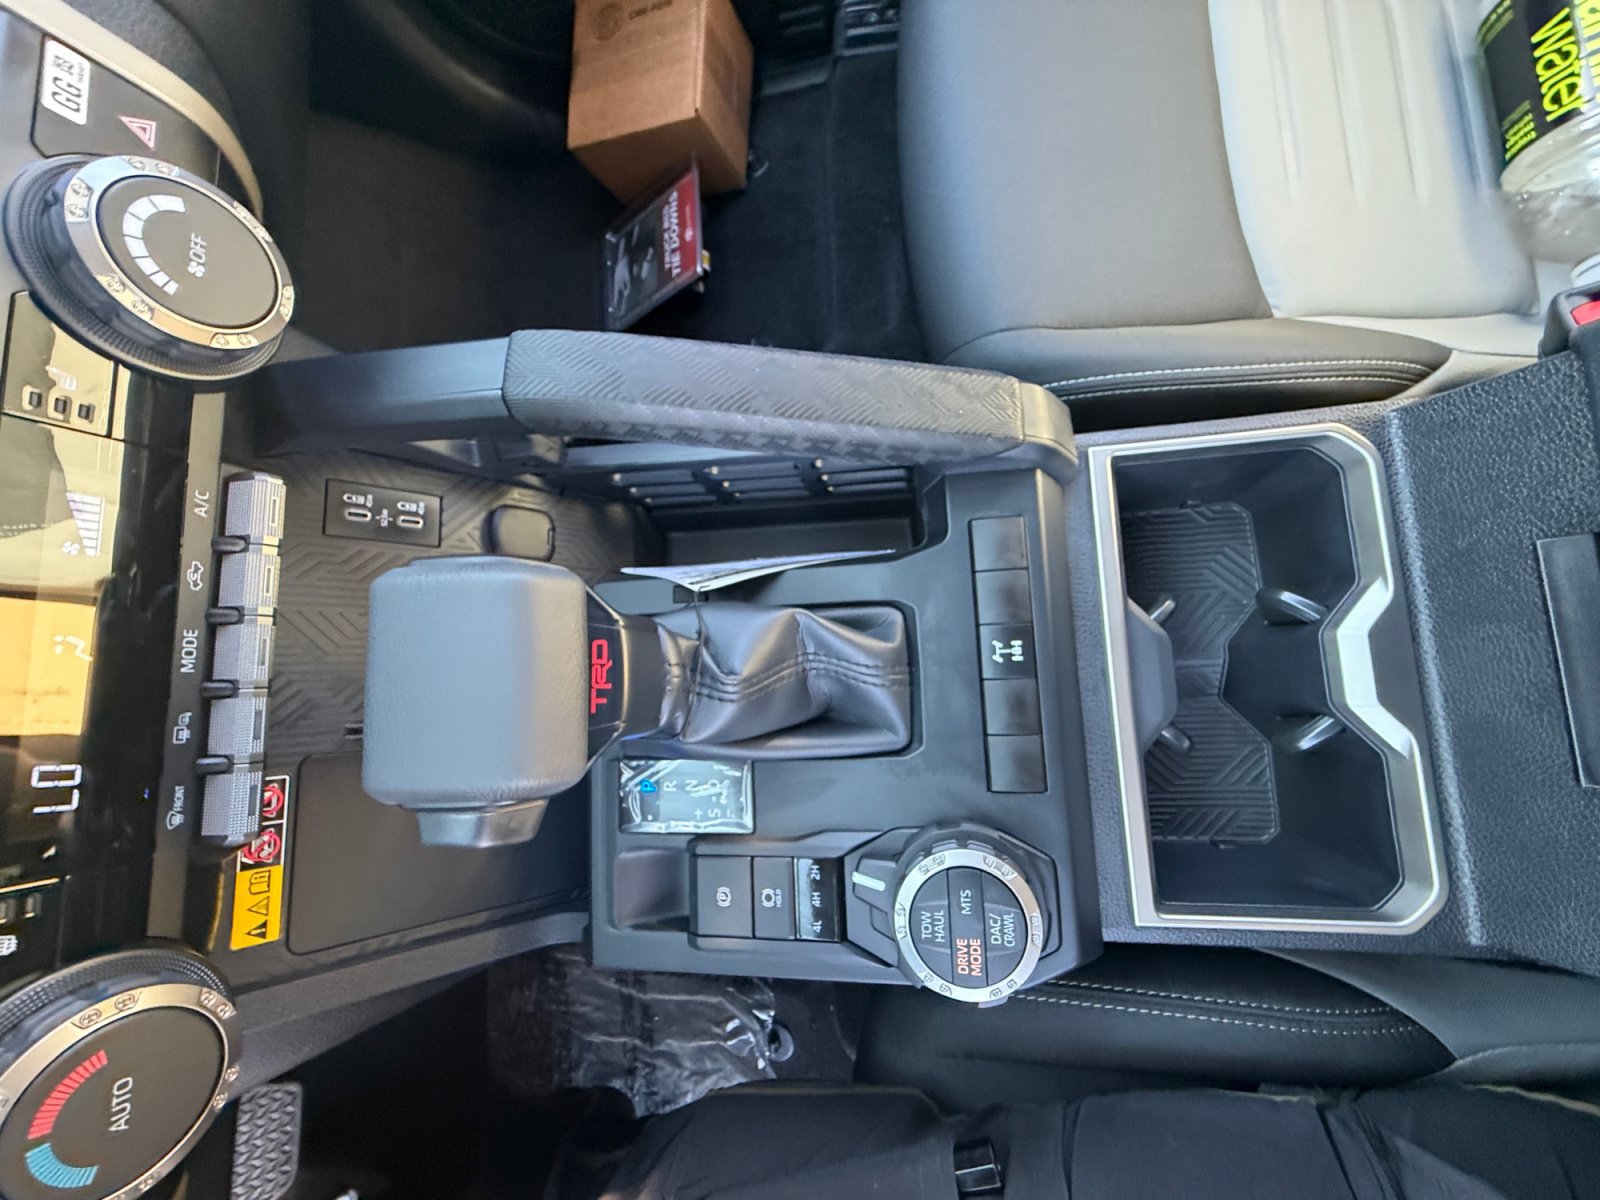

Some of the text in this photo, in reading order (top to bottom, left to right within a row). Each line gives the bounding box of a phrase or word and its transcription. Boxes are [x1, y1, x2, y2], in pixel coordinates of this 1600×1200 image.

[190, 232, 207, 263] OFF
[668, 191, 681, 277] TIE DOWNS
[194, 490, 209, 517] A/C
[180, 629, 198, 673] MODE
[590, 639, 613, 714] TRD
[172, 785, 184, 811] FRONT
[640, 779, 657, 793] P
[664, 780, 677, 792] R
[810, 864, 822, 933] 4L 4H 2H
[960, 889, 972, 914] MTS
[921, 911, 931, 939] TOW
[934, 910, 945, 942] HAUL
[989, 914, 1002, 944] DAC/
[1004, 913, 1015, 947] CRAWL
[956, 938, 969, 974] DRIVE
[970, 938, 982, 976] MODE
[108, 1075, 133, 1132] AUTO
